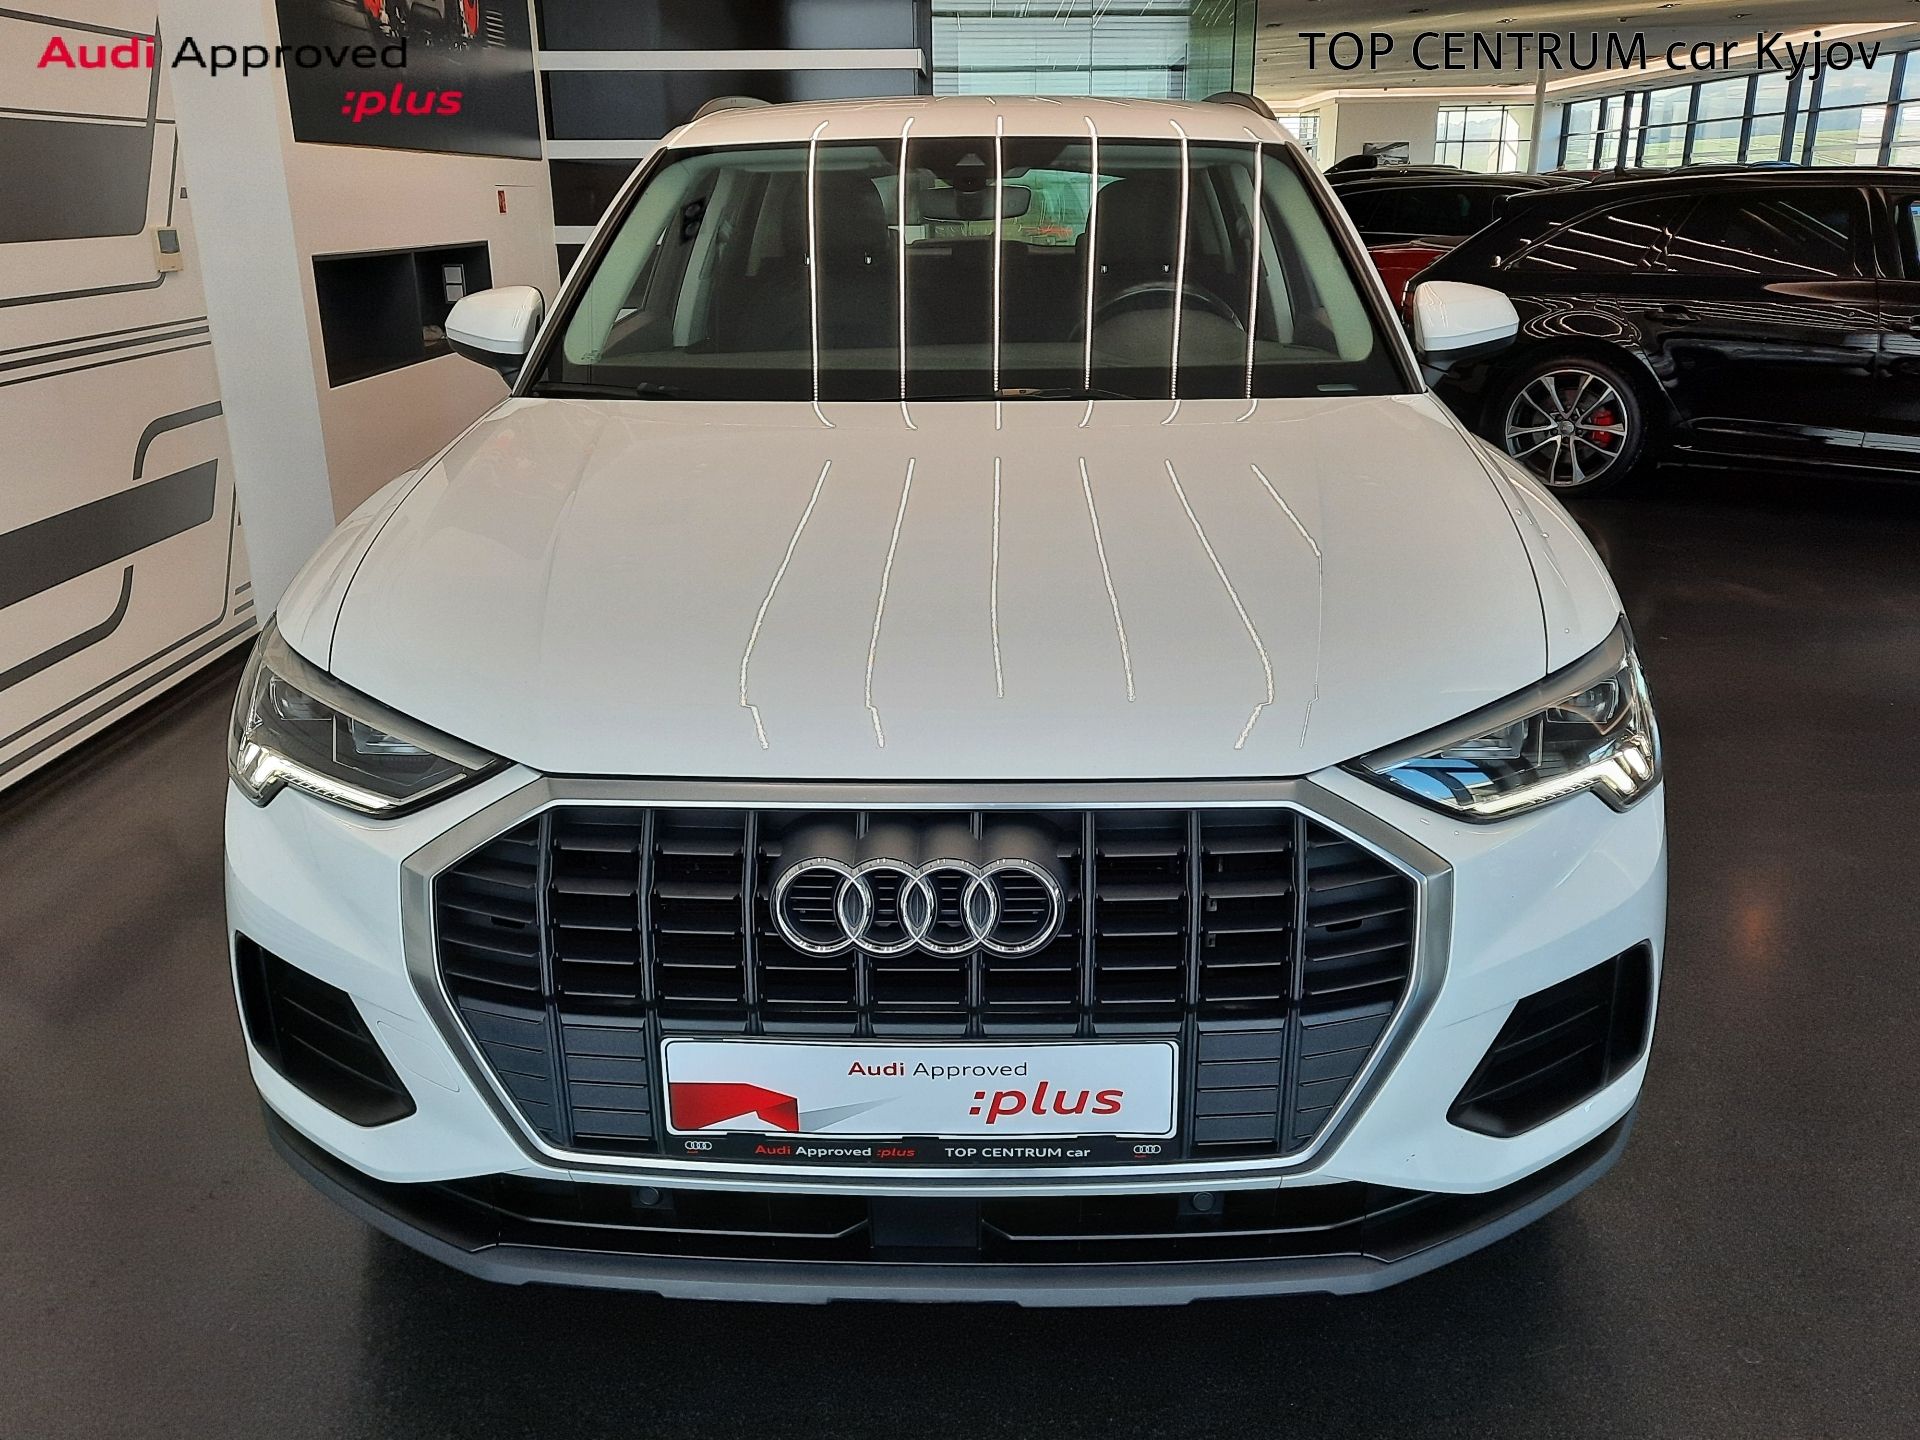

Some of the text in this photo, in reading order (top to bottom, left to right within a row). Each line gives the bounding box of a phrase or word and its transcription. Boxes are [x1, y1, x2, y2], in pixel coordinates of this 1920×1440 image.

[848, 1062, 1028, 1080] Audi Approved
[969, 1081, 1124, 1125] :plus
[755, 1144, 791, 1155] Audi
[795, 1145, 872, 1157] Approved
[945, 1147, 977, 1158] TOP
[982, 1147, 1061, 1158] CENTRUM
[1066, 1149, 1091, 1158] car
